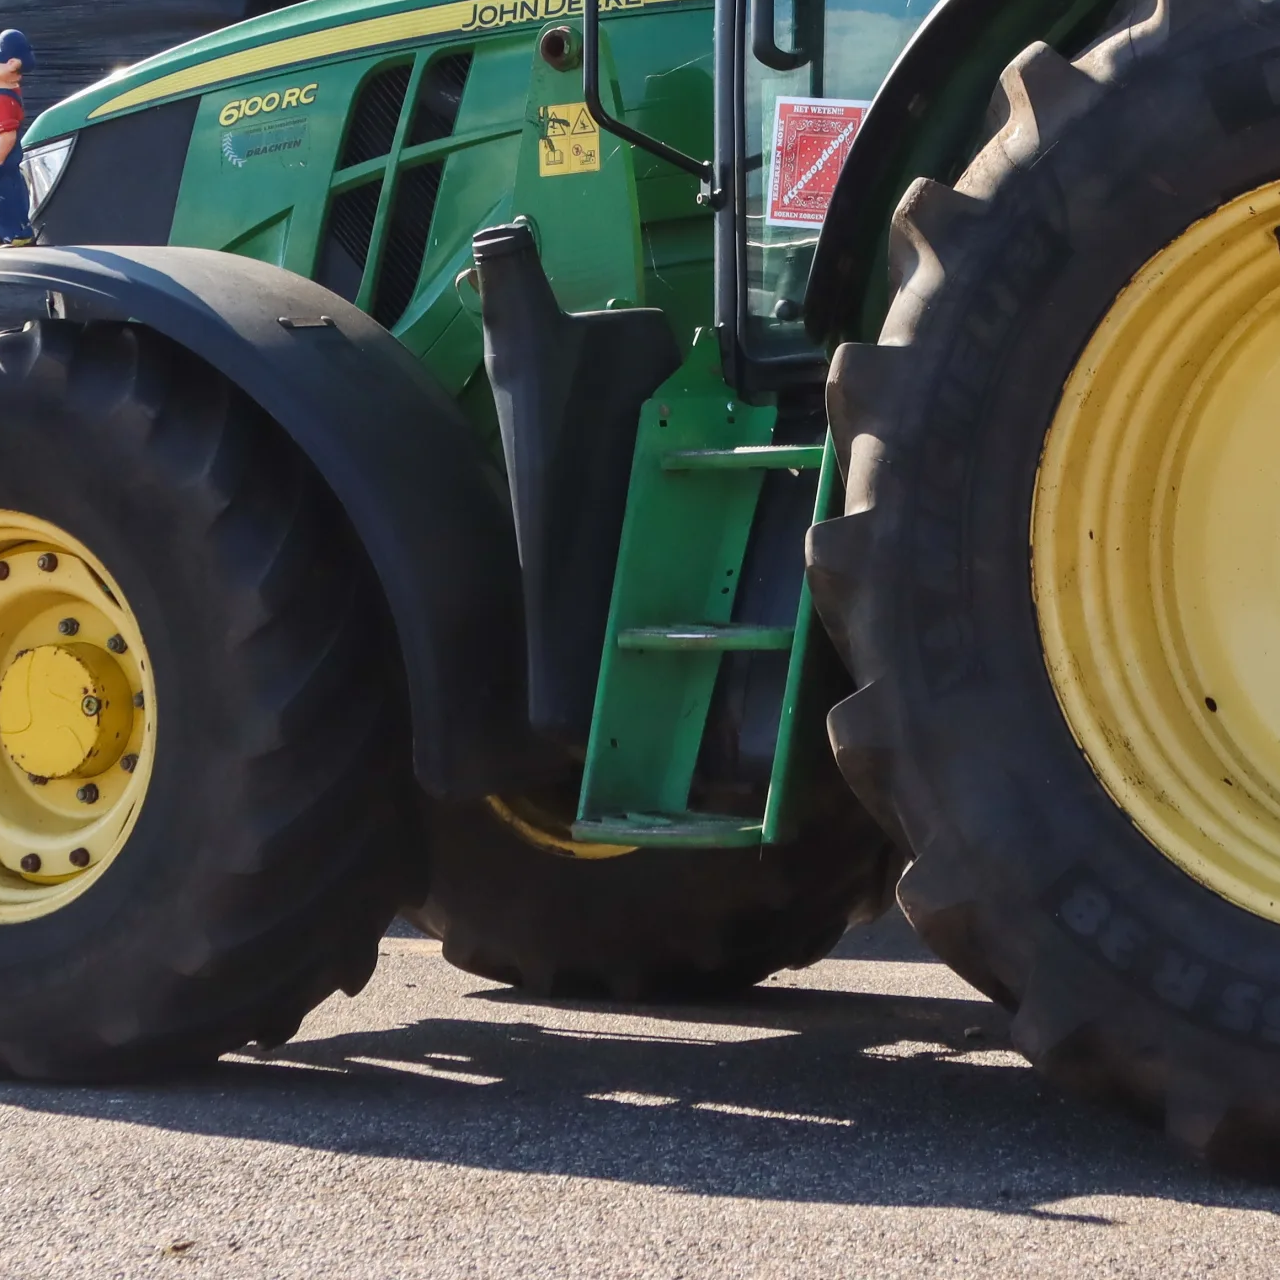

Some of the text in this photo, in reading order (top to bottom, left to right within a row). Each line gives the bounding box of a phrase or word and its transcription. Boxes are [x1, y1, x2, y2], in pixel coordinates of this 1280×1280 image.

[219, 92, 280, 126] 6100
[281, 83, 318, 109] RC
[793, 105, 844, 115] HET WETEN!!!
[246, 139, 301, 158] DRACHTEN
[783, 122, 854, 205] #trotsopdeboer
[773, 150, 782, 200] IEDEREEN
[773, 210, 824, 220] BOEREN ZORGEN
